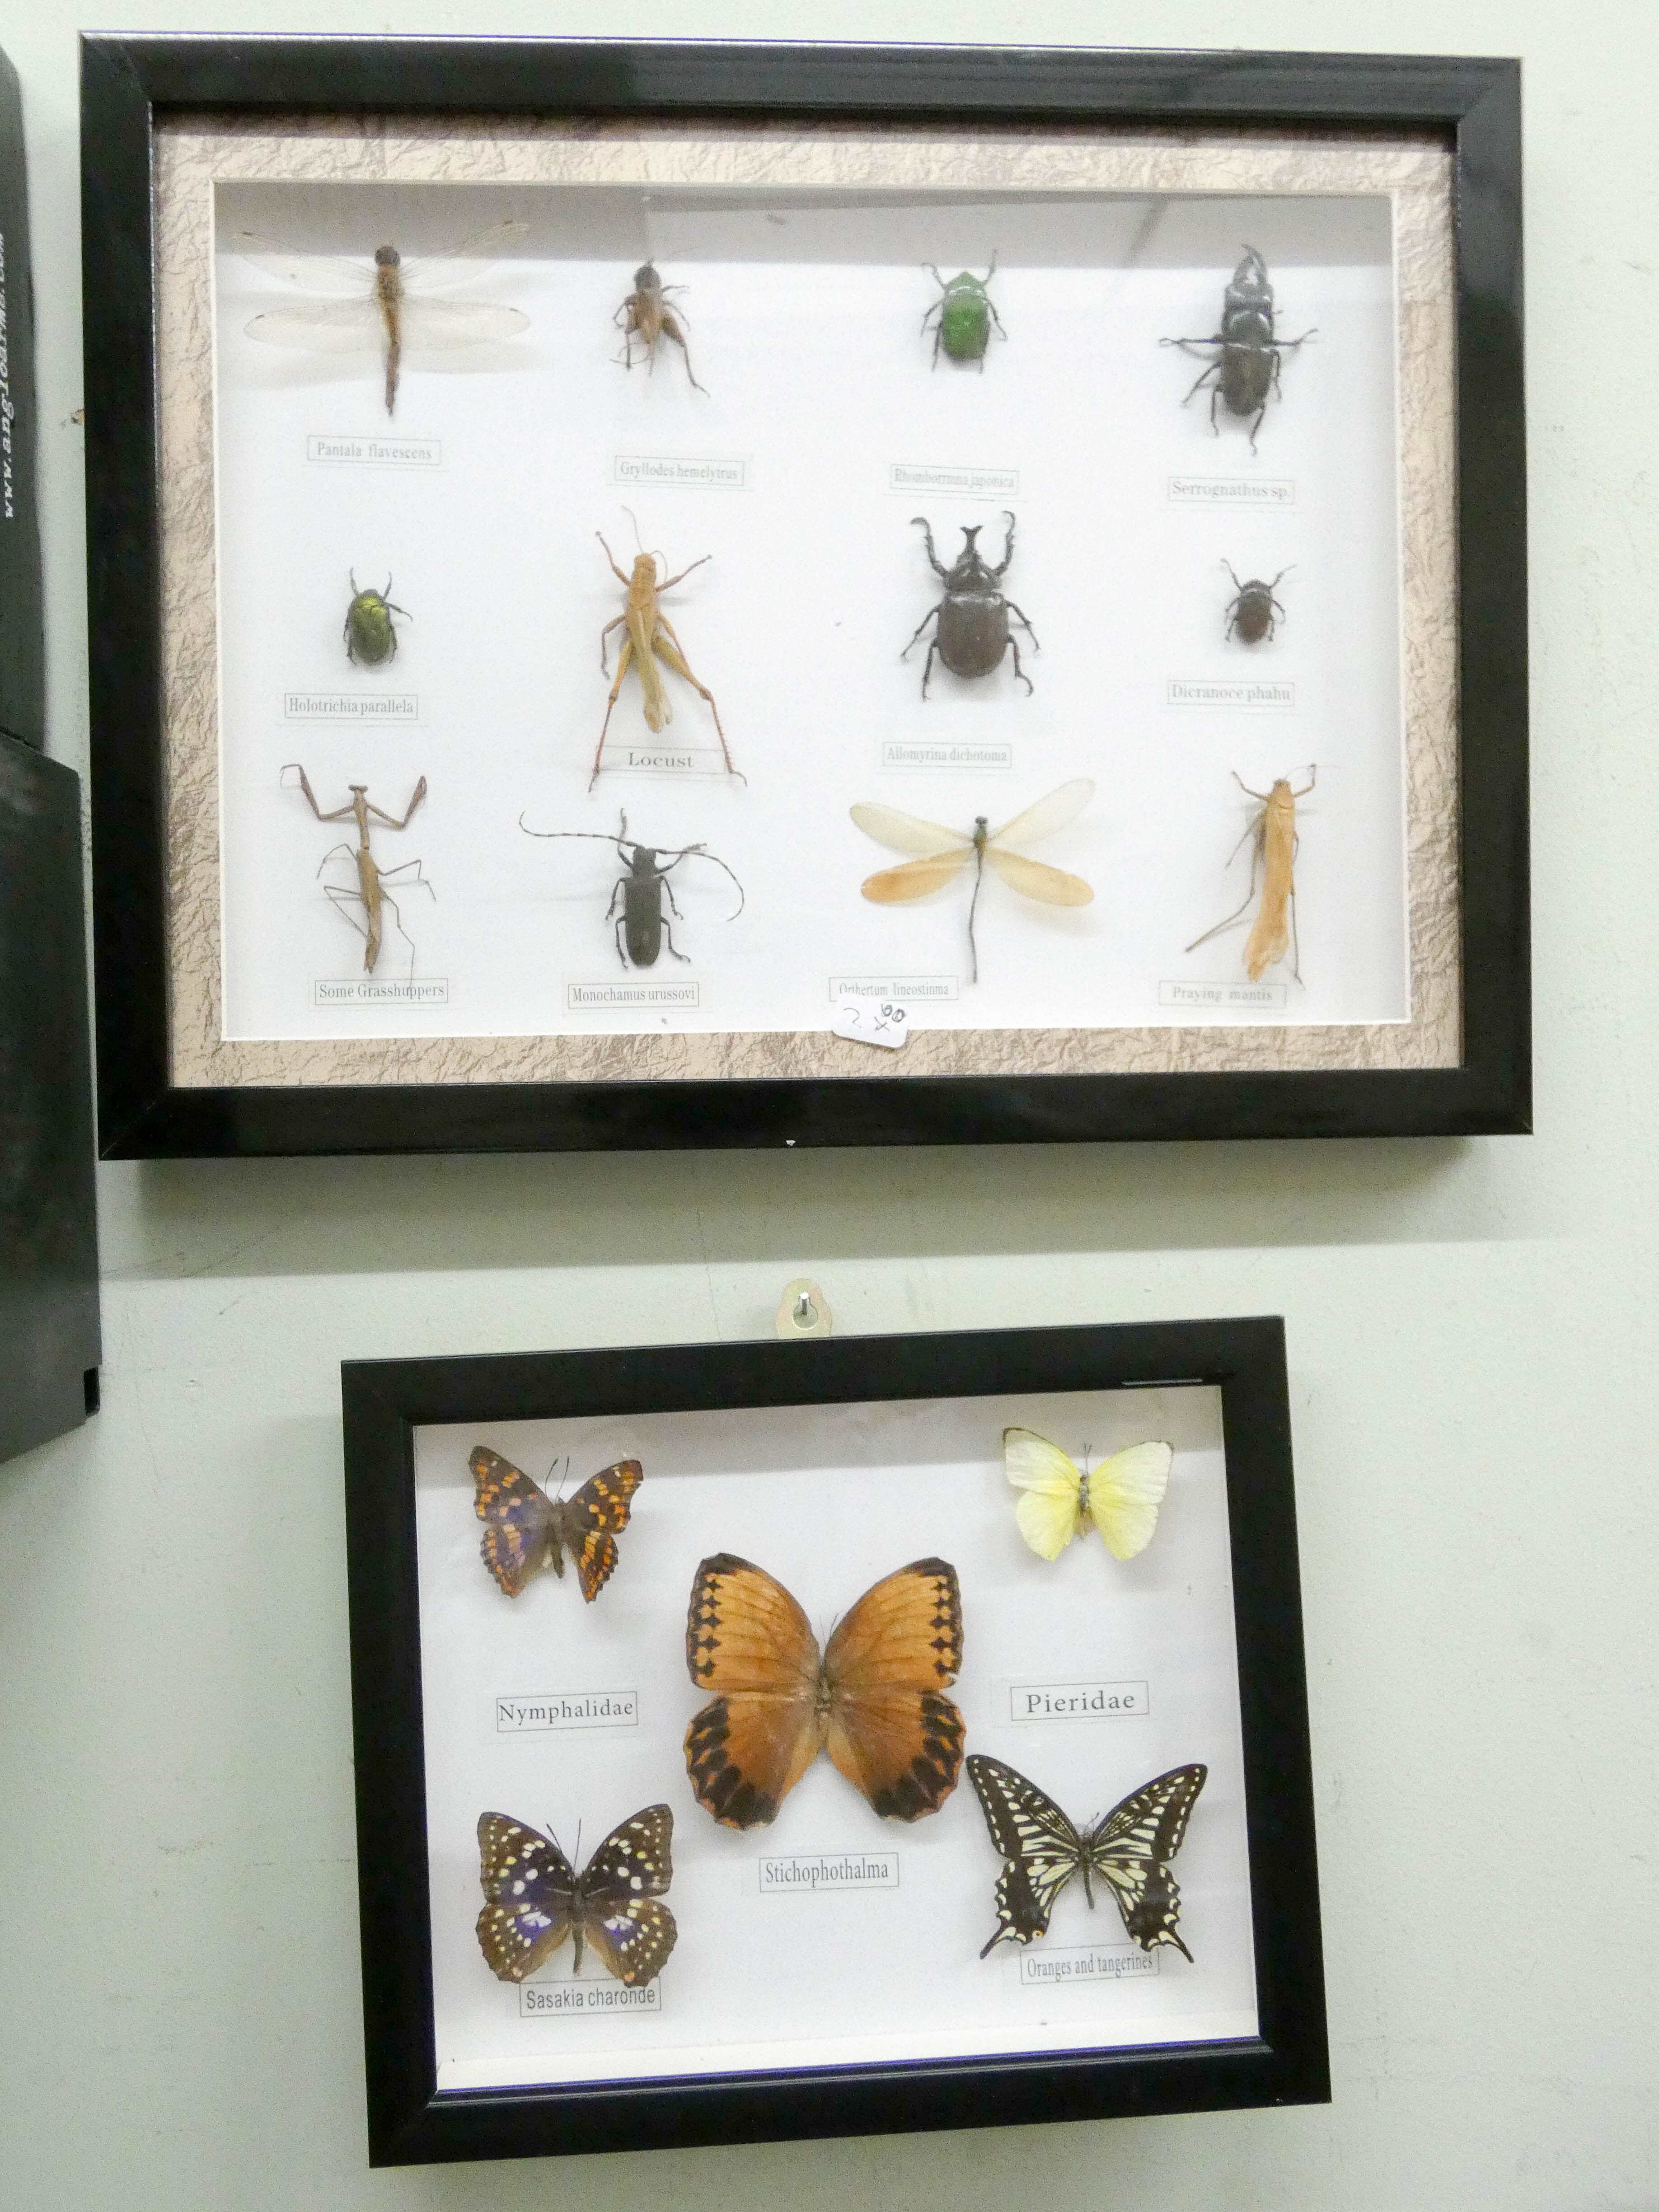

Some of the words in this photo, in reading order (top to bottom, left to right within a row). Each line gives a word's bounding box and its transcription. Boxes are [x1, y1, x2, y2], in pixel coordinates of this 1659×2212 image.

[318, 441, 361, 455] Pantala
[369, 442, 432, 458] flavescens
[1172, 479, 1268, 497] Serrognathus
[289, 696, 358, 711] Holotrichia
[361, 698, 413, 713] parallela
[629, 750, 694, 766] Locust
[887, 745, 947, 761] Allomyrina
[950, 745, 1007, 760] dichotoma
[319, 983, 354, 997] Some
[573, 986, 645, 1000] Monochamus
[649, 985, 694, 998] urussovi
[1173, 985, 1222, 1001] Praying
[1229, 988, 1272, 999] mantis
[1026, 1690, 1136, 1714] Pieridae
[498, 1699, 633, 1726] Nymphalidae
[766, 1857, 889, 1888] Stichophothalma
[1027, 1958, 1071, 1982] Oranges
[1075, 1953, 1094, 1974] and
[1097, 1952, 1153, 1978] tangerines
[526, 1989, 584, 2009] Sasakia
[588, 1988, 656, 2006] charonde
